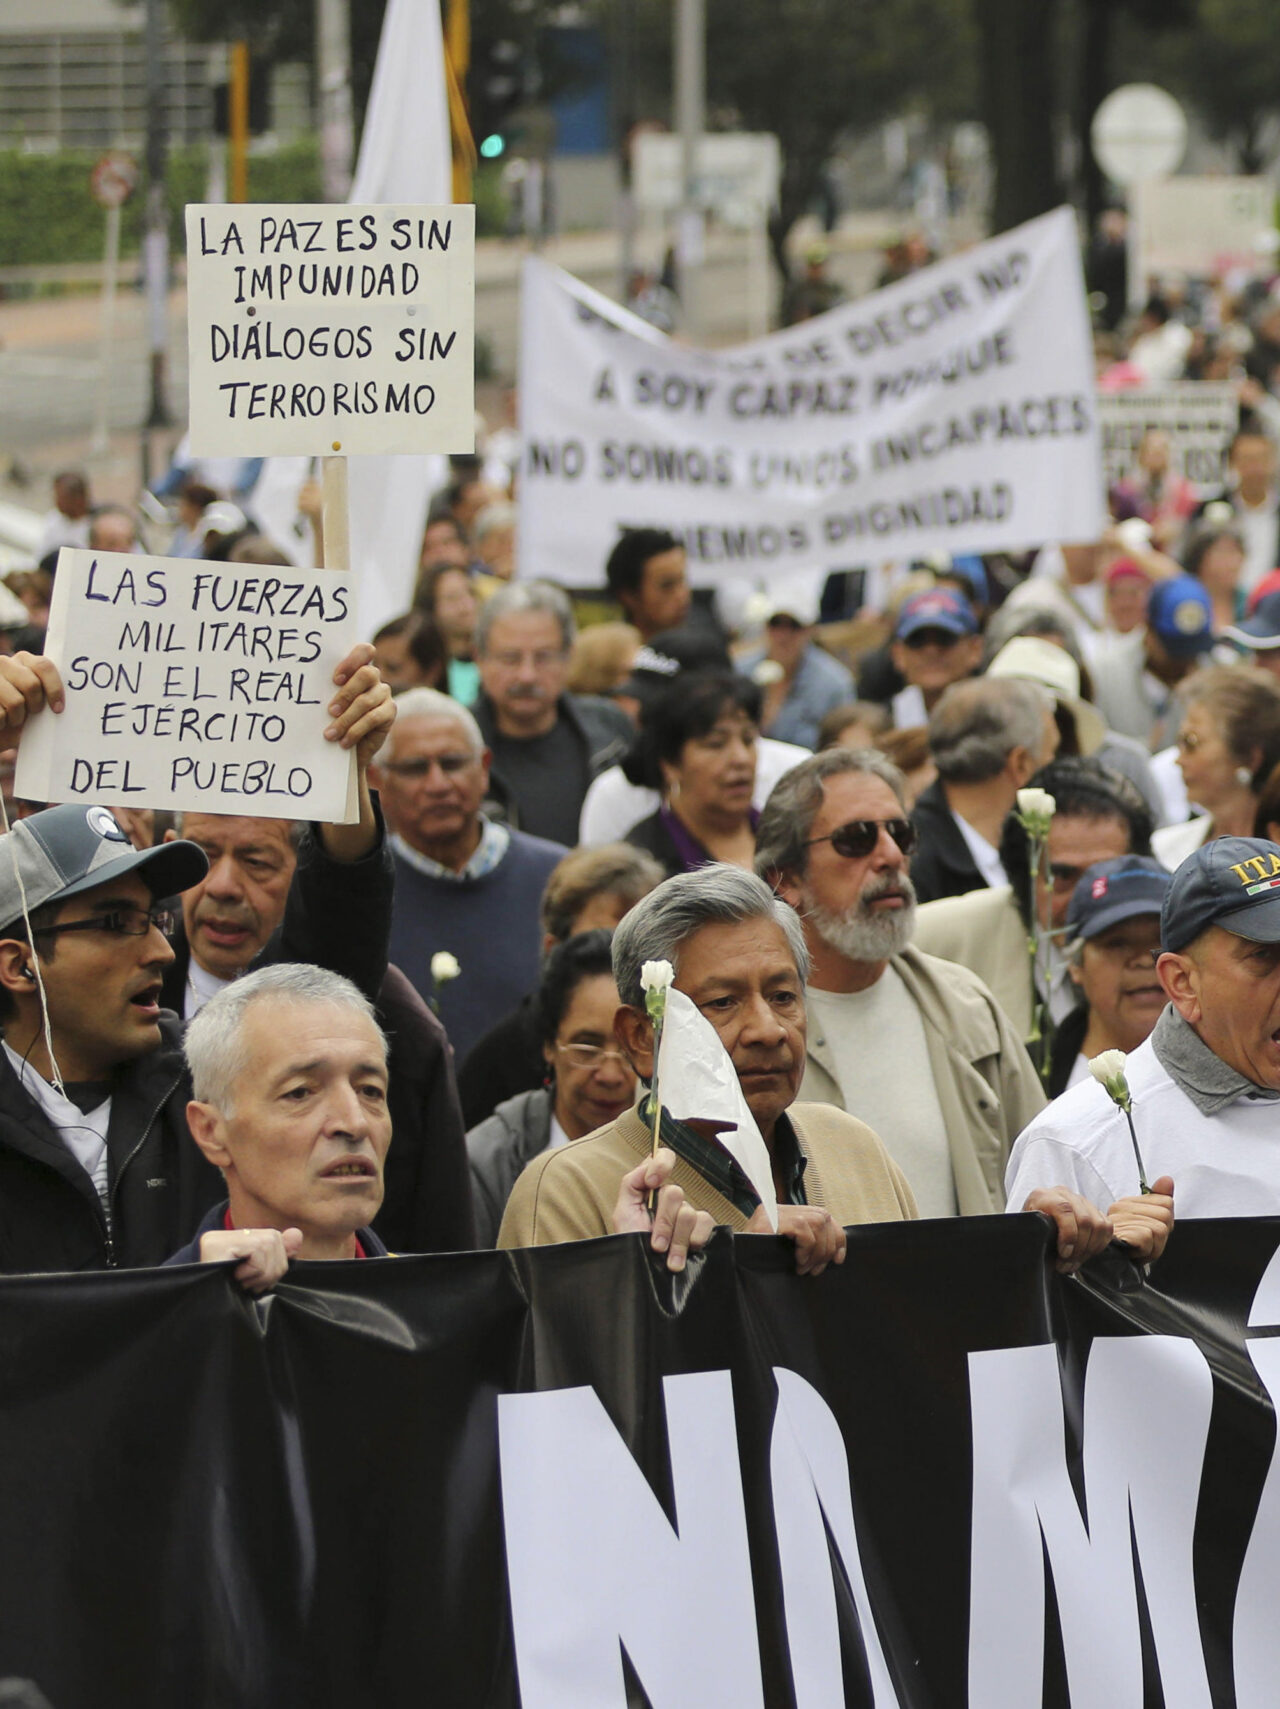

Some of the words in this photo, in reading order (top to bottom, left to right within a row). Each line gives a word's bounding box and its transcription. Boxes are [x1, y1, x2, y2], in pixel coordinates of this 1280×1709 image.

[200, 216, 245, 257] LA
[259, 216, 326, 254] PAZ
[336, 214, 378, 253] ES
[390, 218, 452, 252] SIN
[233, 262, 420, 304] IMPUNIDAD
[210, 320, 373, 363] DIÁLOGOS
[394, 327, 457, 363] SIN
[218, 380, 436, 420] TERRORISMO
[593, 366, 615, 401] A
[634, 368, 713, 412] SOY
[729, 374, 857, 418] CAPAZ
[526, 441, 585, 479] NO
[601, 440, 731, 487] SOMOS
[870, 394, 1091, 474] INCAPACES
[823, 482, 1014, 546] DIGNIDAD
[84, 559, 167, 608] LAS
[191, 574, 349, 622] FUERZAS
[117, 620, 322, 664] MILITARES
[66, 655, 143, 695] SON
[162, 665, 218, 702] EL
[229, 667, 321, 706] REAL
[100, 697, 286, 743] EJÉRCITO
[69, 758, 147, 794] DEL
[170, 756, 313, 798] PUEBLO
